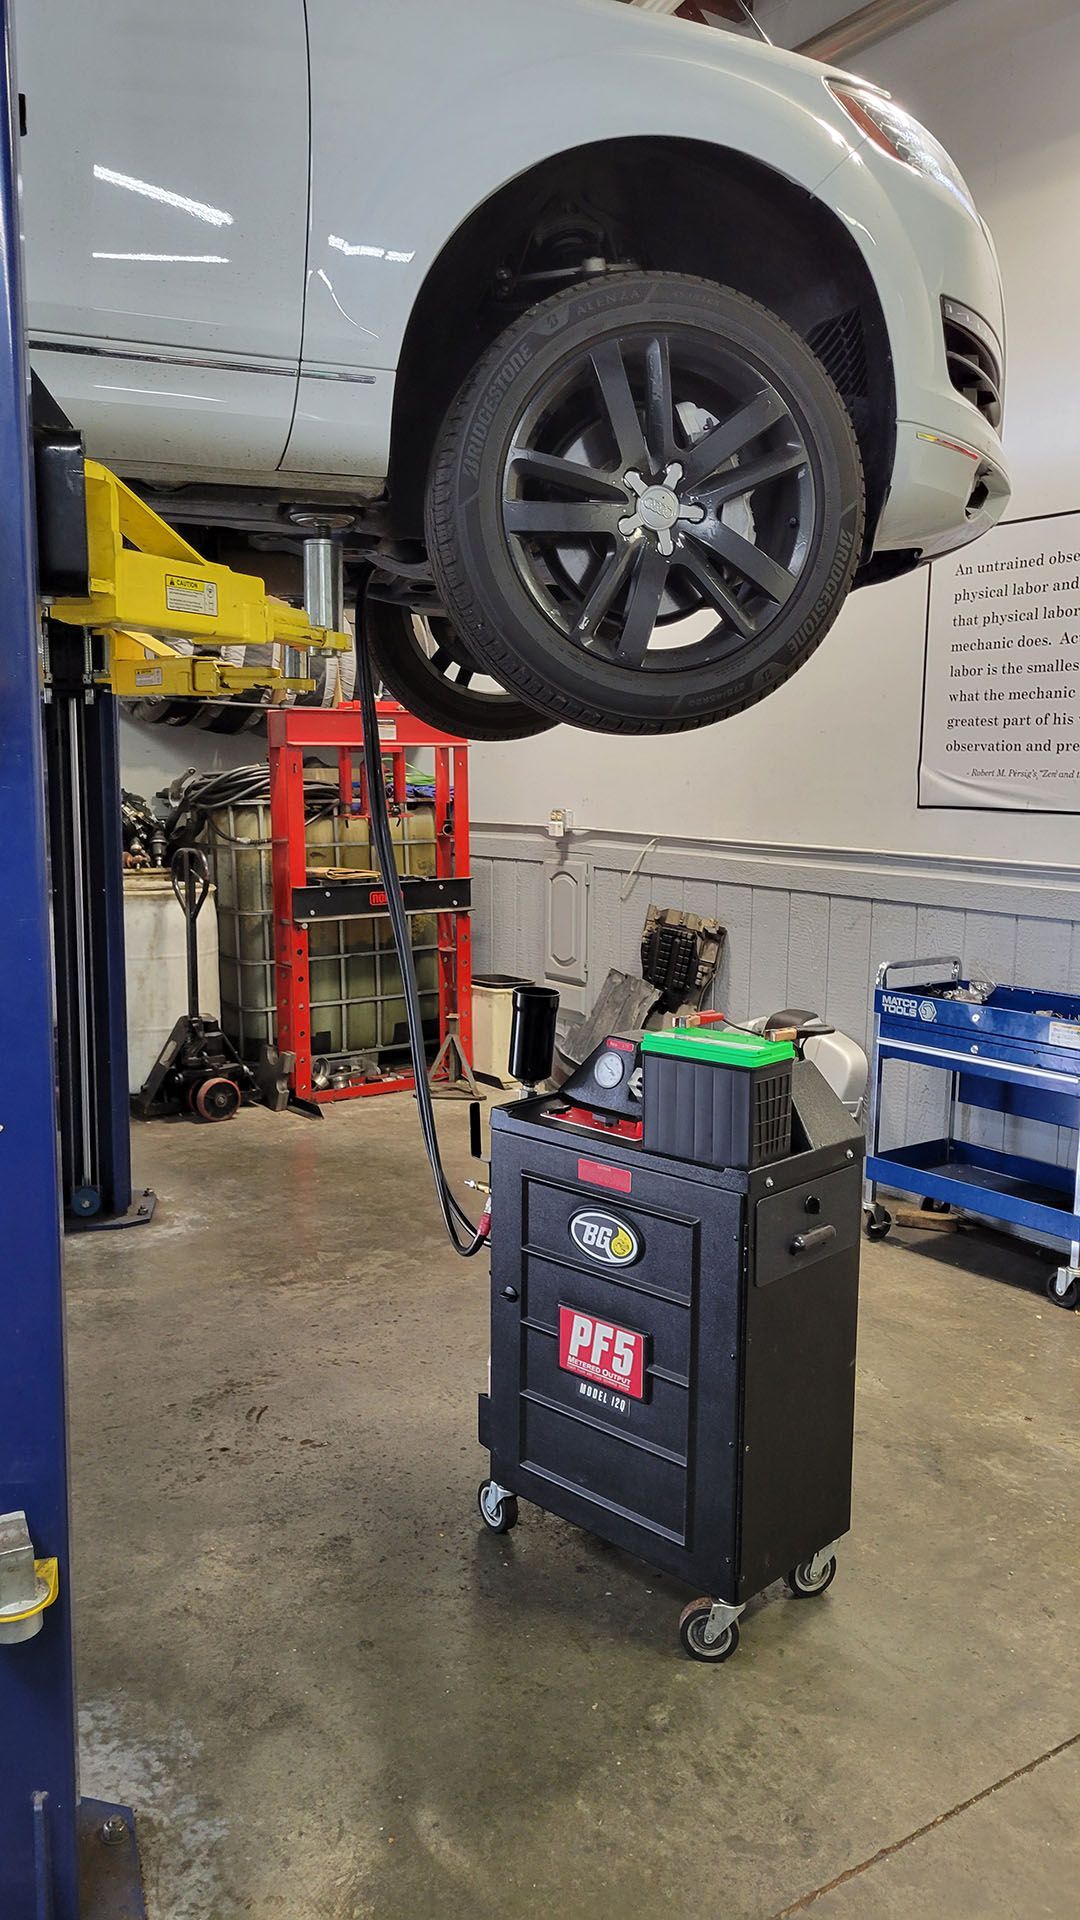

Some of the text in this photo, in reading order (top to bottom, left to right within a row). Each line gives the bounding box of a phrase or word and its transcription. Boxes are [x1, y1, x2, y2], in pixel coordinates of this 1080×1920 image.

[462, 342, 534, 480] BRIDGESTONE
[955, 563, 973, 576] An
[977, 553, 1044, 574] untrained
[786, 527, 854, 656] BRIDGESTONE
[954, 576, 1079, 604] physical labor and
[953, 605, 1080, 627] that physical labor
[951, 631, 1080, 652] mechanic does. Ac
[950, 664, 983, 677] labor
[987, 663, 998, 675] is
[1001, 662, 1023, 675] the
[949, 686, 1076, 702] what the mechanic
[947, 712, 1074, 729] greatest part of his
[945, 740, 1022, 752] observation
[1025, 739, 1052, 752] and
[971, 768, 995, 778] Robert
[1058, 769, 1076, 779] and
[882, 995, 918, 1009] MATCO
[882, 1003, 918, 1017] TOOLS
[582, 1222, 613, 1249] BG
[568, 1314, 636, 1377] PF5
[567, 1355, 601, 1374] METERED
[602, 1368, 632, 1386] OUTPUT
[579, 1382, 607, 1404] MODEL
